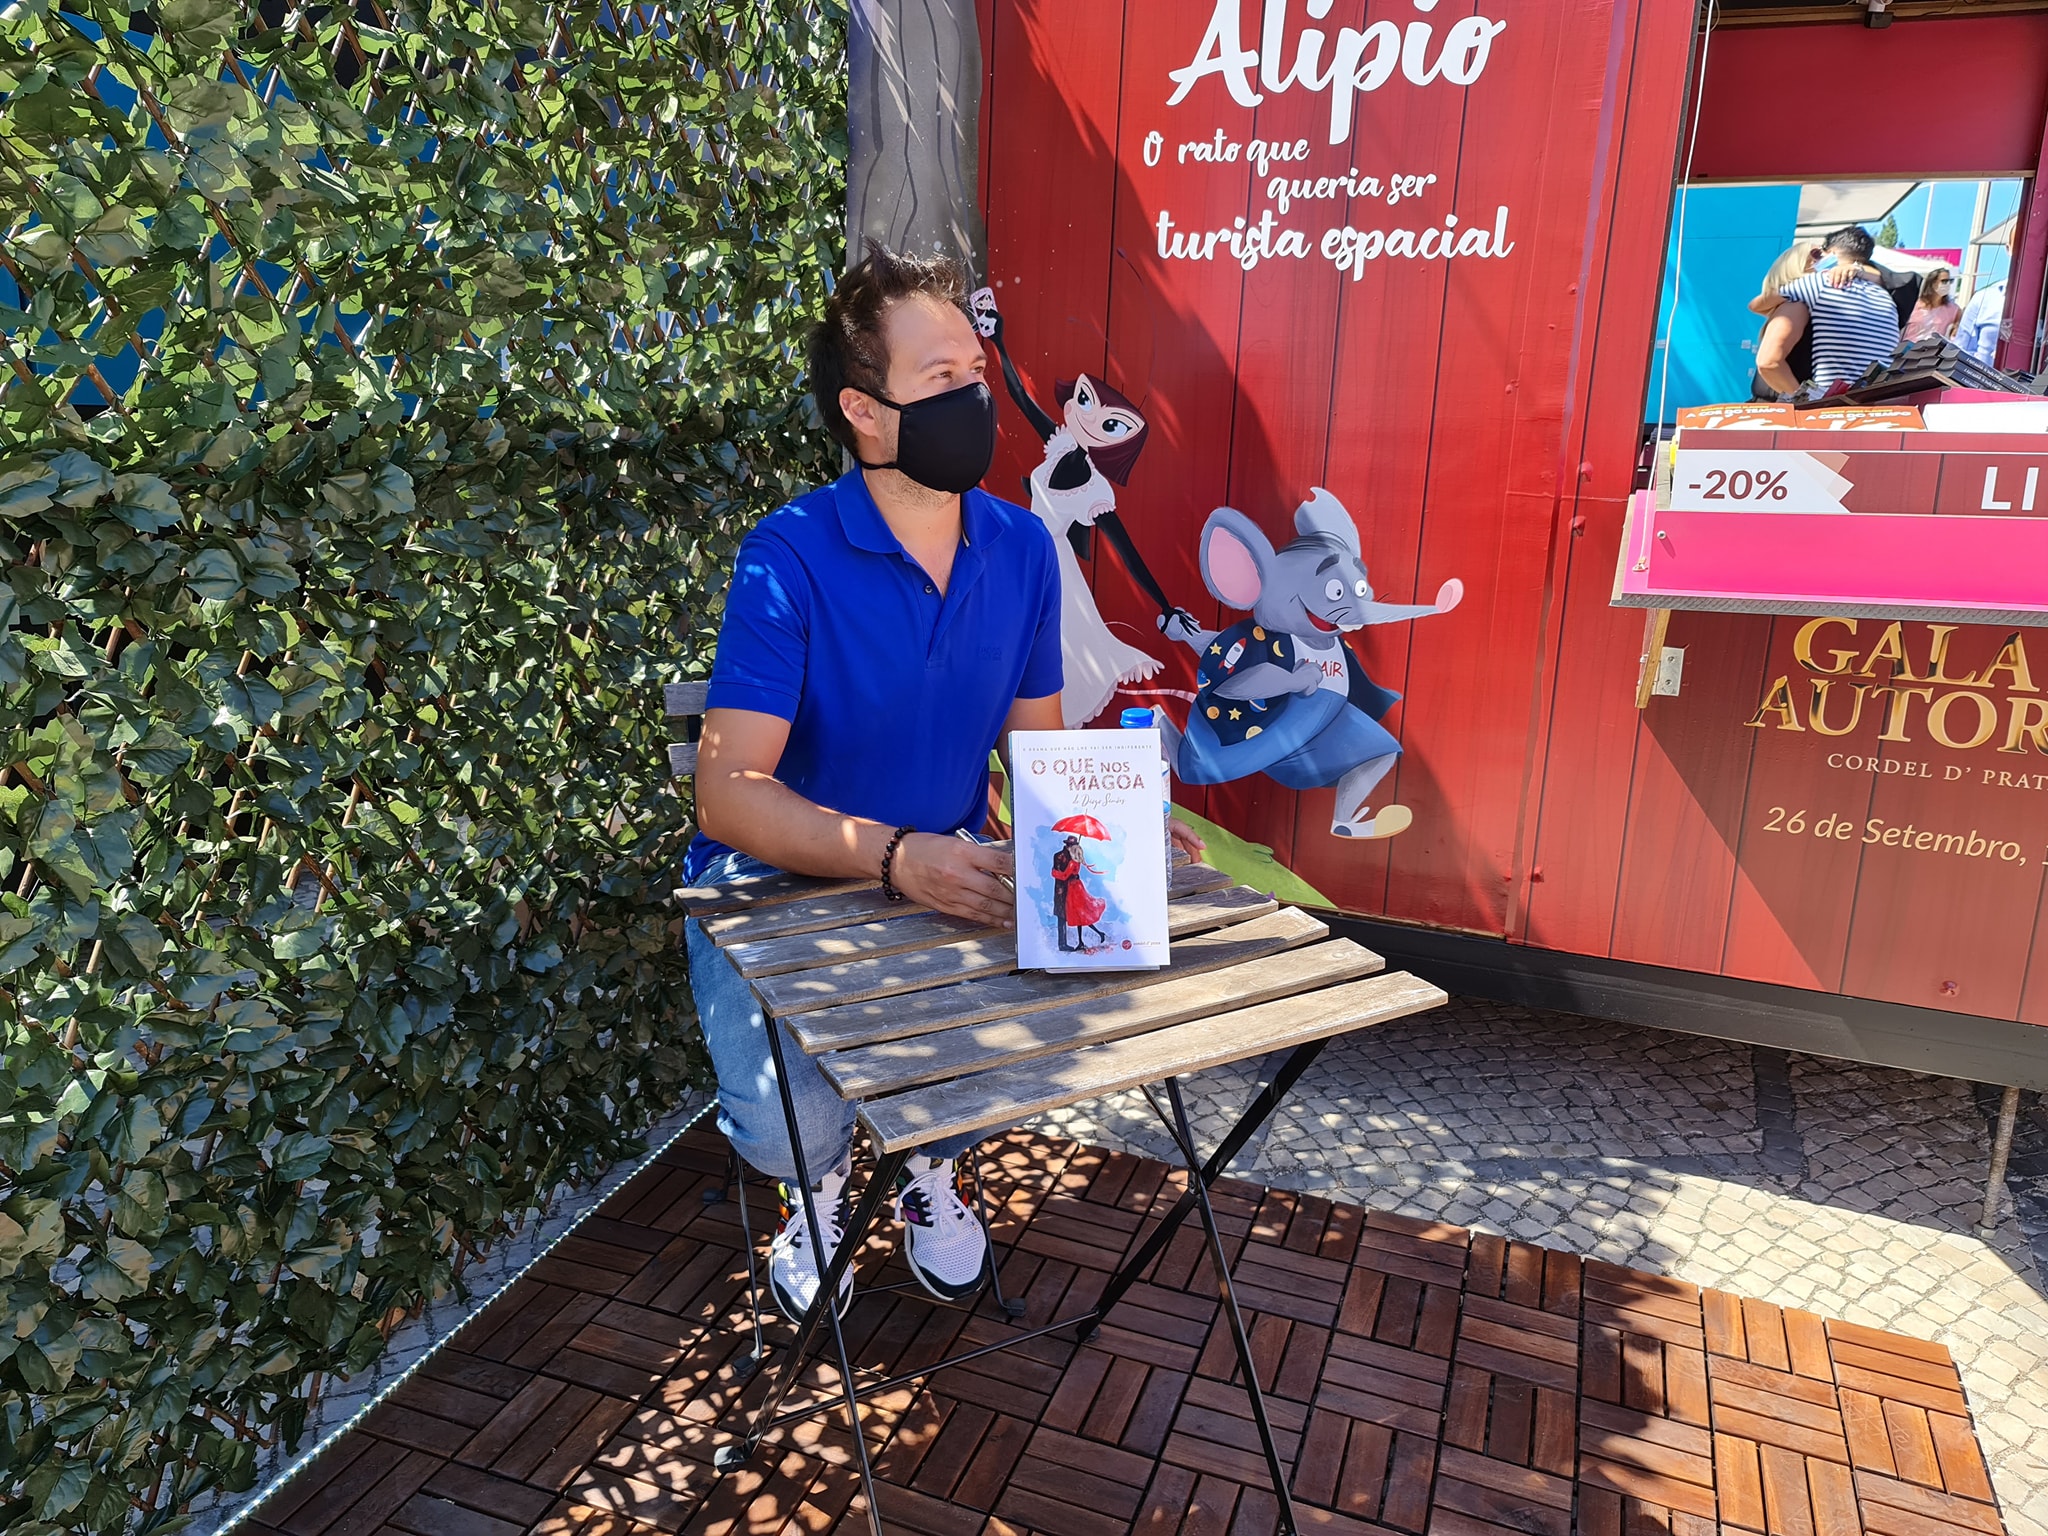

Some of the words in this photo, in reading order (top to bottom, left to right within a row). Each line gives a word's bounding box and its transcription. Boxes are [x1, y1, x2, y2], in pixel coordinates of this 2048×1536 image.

[1143, 130, 1164, 167] O
[1177, 128, 1241, 164] rato
[1246, 138, 1310, 177] que
[1267, 167, 1384, 214] queria
[1387, 172, 1437, 206] ser
[1156, 210, 1311, 271] turista
[1320, 206, 1515, 282] espacial
[1688, 469, 1789, 501] -20%
[1980, 465, 2040, 511] LI
[1793, 616, 2040, 692] GALA
[1744, 675, 2048, 757] AUTOR
[1031, 759, 1047, 775] O
[1053, 757, 1095, 776] QUE
[1100, 761, 1130, 773] NOS
[1068, 774, 1145, 791] MAGOA
[1827, 753, 1933, 778] CORDEL
[1763, 806, 1806, 834] 26
[1814, 812, 1853, 840] de
[1862, 818, 2027, 867] Setembro,
